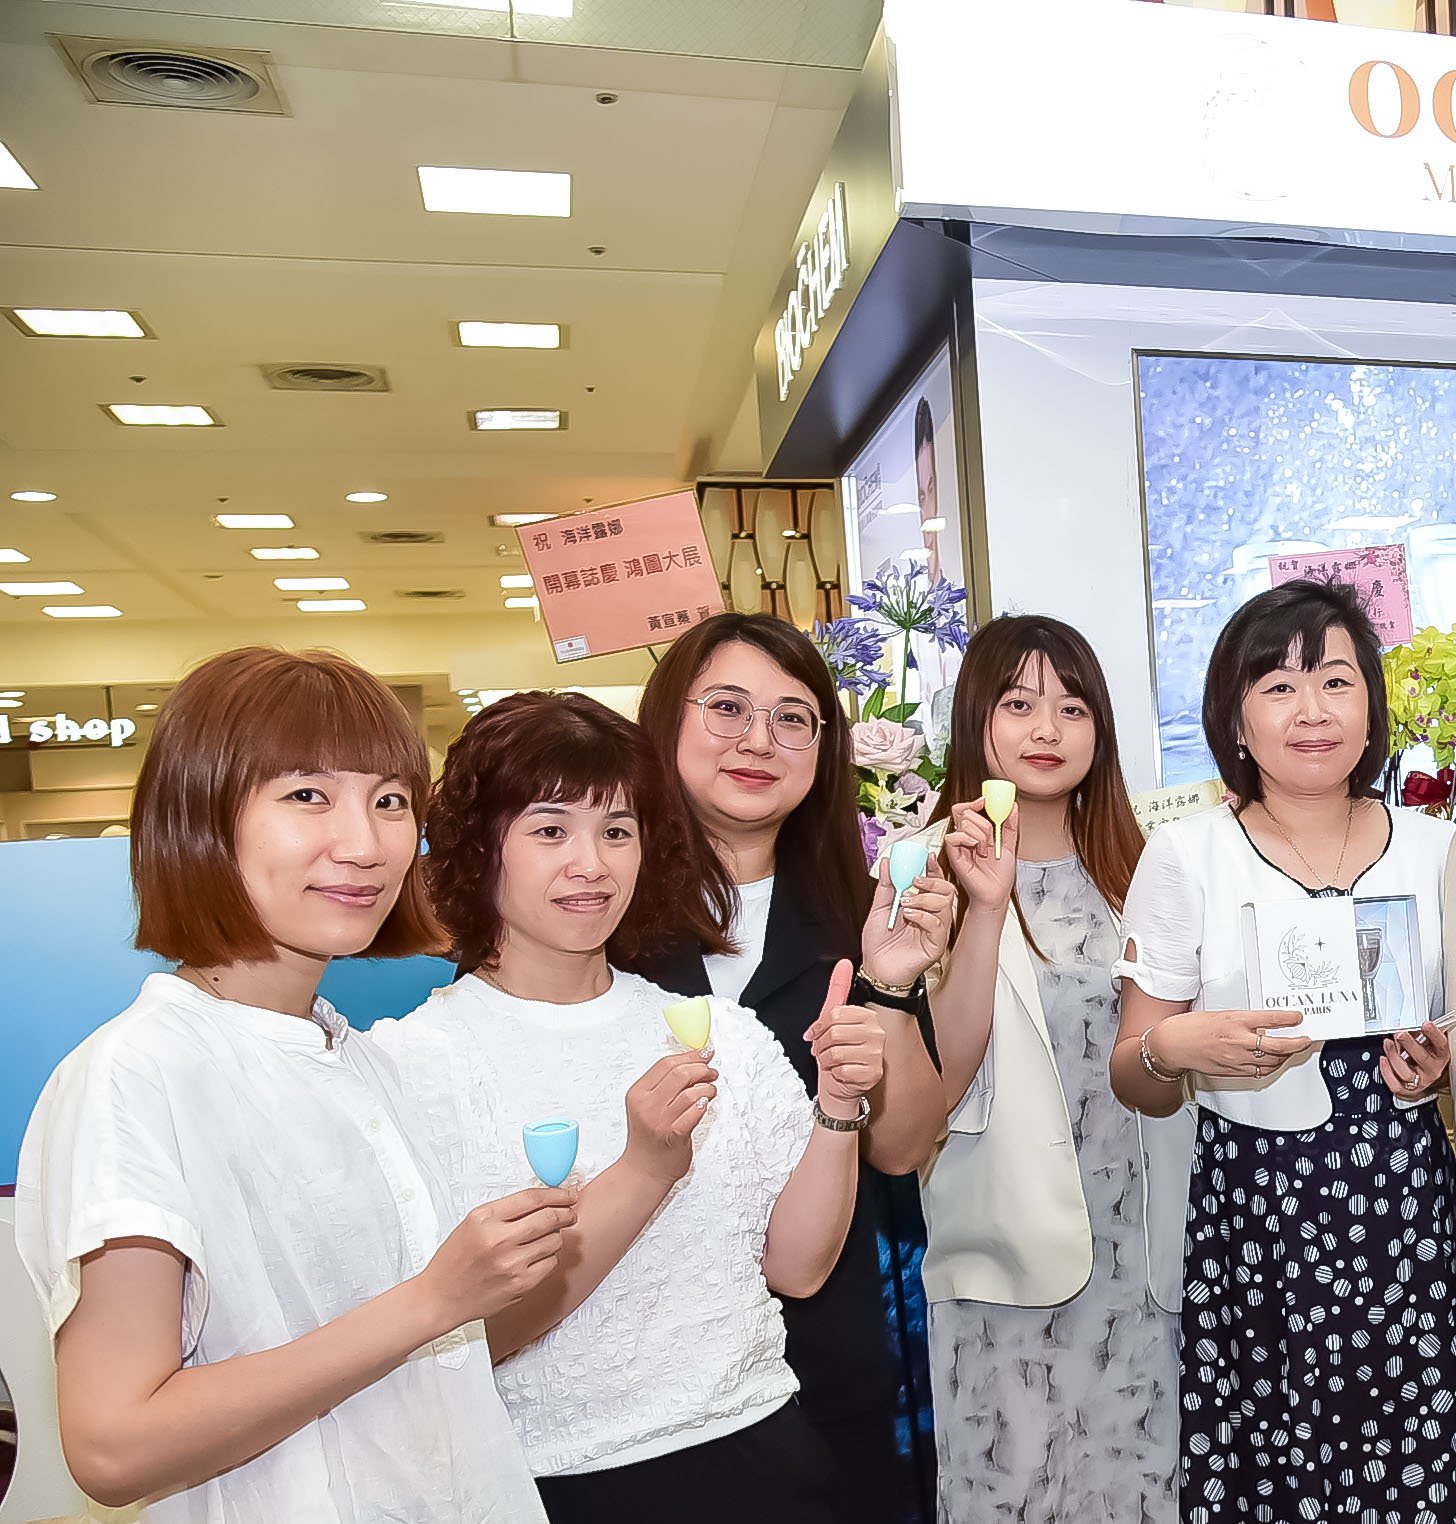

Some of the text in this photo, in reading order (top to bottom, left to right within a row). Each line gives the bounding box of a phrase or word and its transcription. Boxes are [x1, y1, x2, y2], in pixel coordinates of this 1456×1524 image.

[532, 532, 552, 552] 祝
[542, 545, 703, 595] 開幕誌慶 鴻圖大展
[29, 713, 136, 747] shop
[1265, 990, 1358, 1008] OCEAN LUNA
[1303, 1005, 1332, 1015] PARIS
